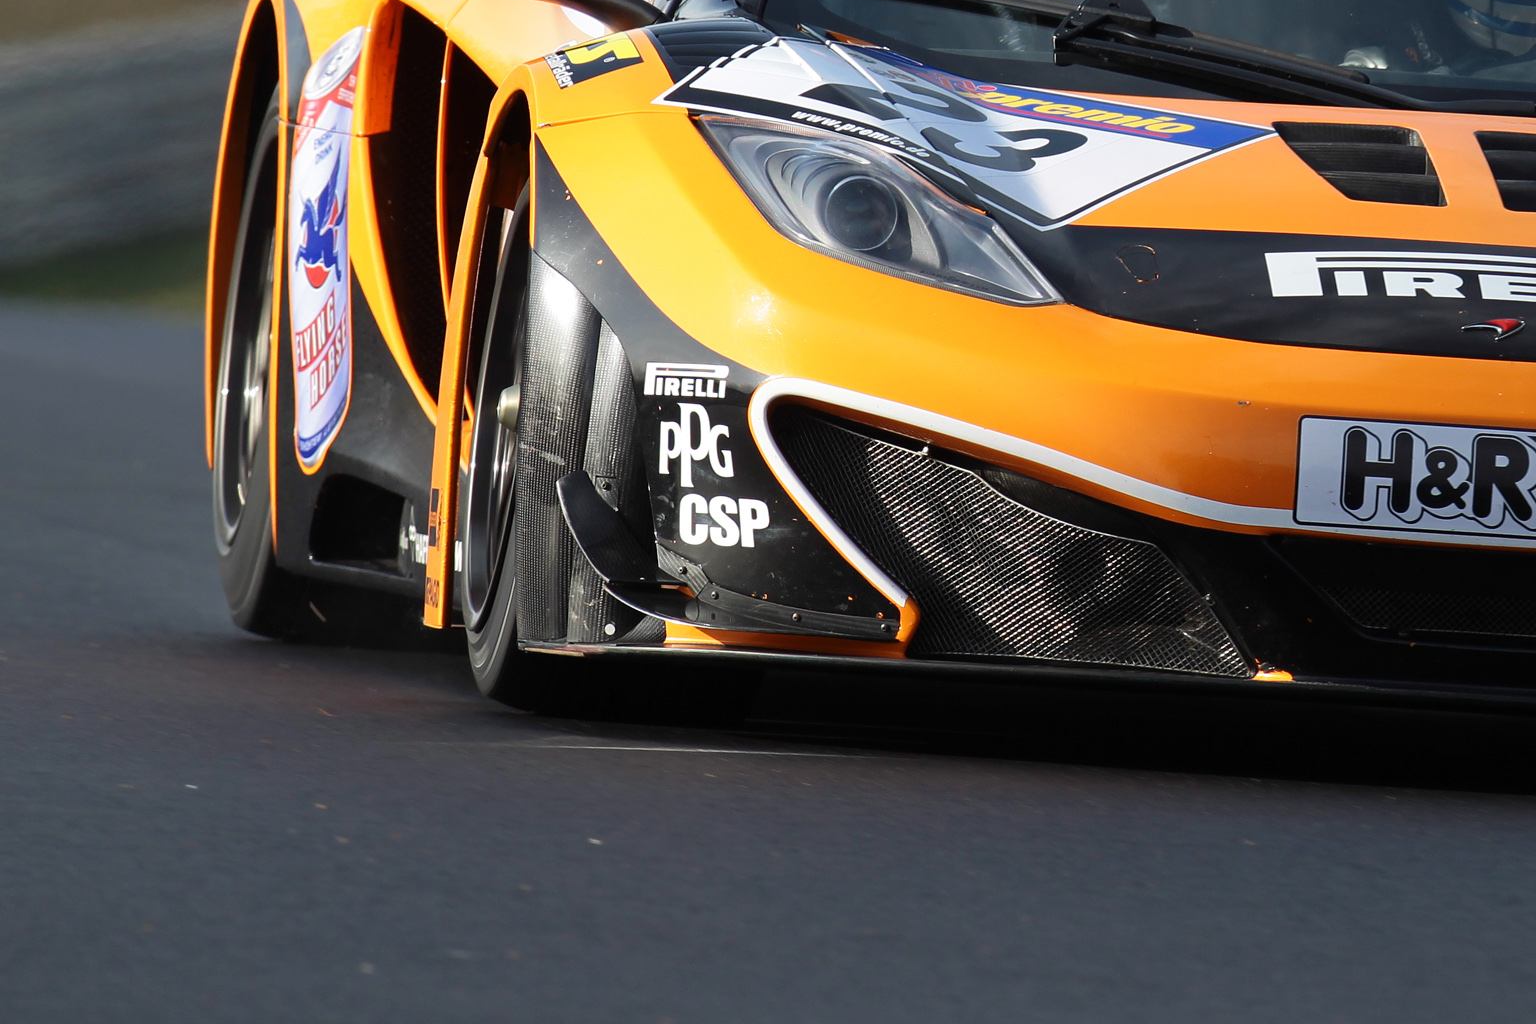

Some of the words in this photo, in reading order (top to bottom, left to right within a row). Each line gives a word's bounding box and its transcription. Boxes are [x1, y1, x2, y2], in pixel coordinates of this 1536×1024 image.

[791, 111, 931, 158] www.premio.de
[799, 80, 1088, 173] 23
[955, 91, 1195, 134] premio
[296, 298, 335, 368] FLYING
[311, 314, 348, 407] HORSE
[644, 362, 729, 398] PIRELLI
[679, 493, 770, 548] CSP
